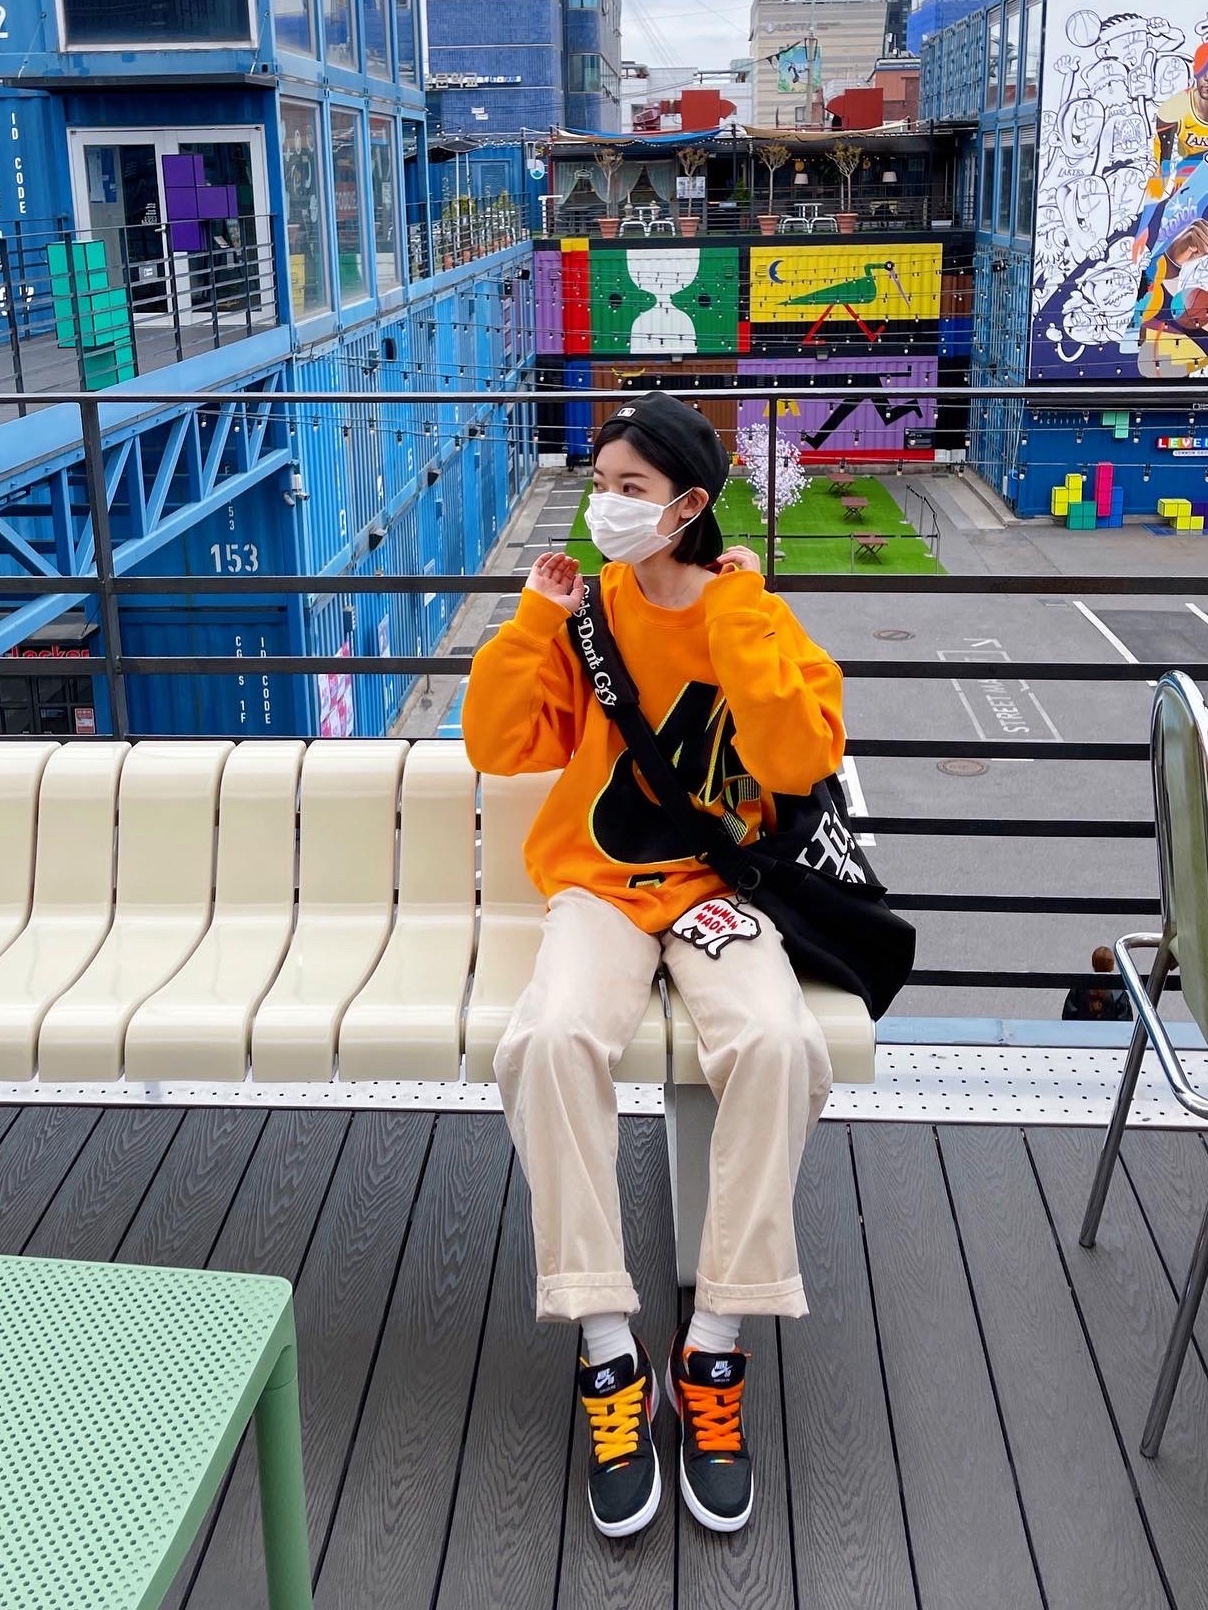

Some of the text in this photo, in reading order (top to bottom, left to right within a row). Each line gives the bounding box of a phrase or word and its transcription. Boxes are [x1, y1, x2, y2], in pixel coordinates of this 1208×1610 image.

[1185, 132, 1208, 148] LAK
[210, 543, 259, 573] 153
[262, 675, 272, 724] CODE
[985, 694, 1030, 733] STREET
[694, 913, 726, 934] MADE
[702, 903, 738, 930] HUMAN
